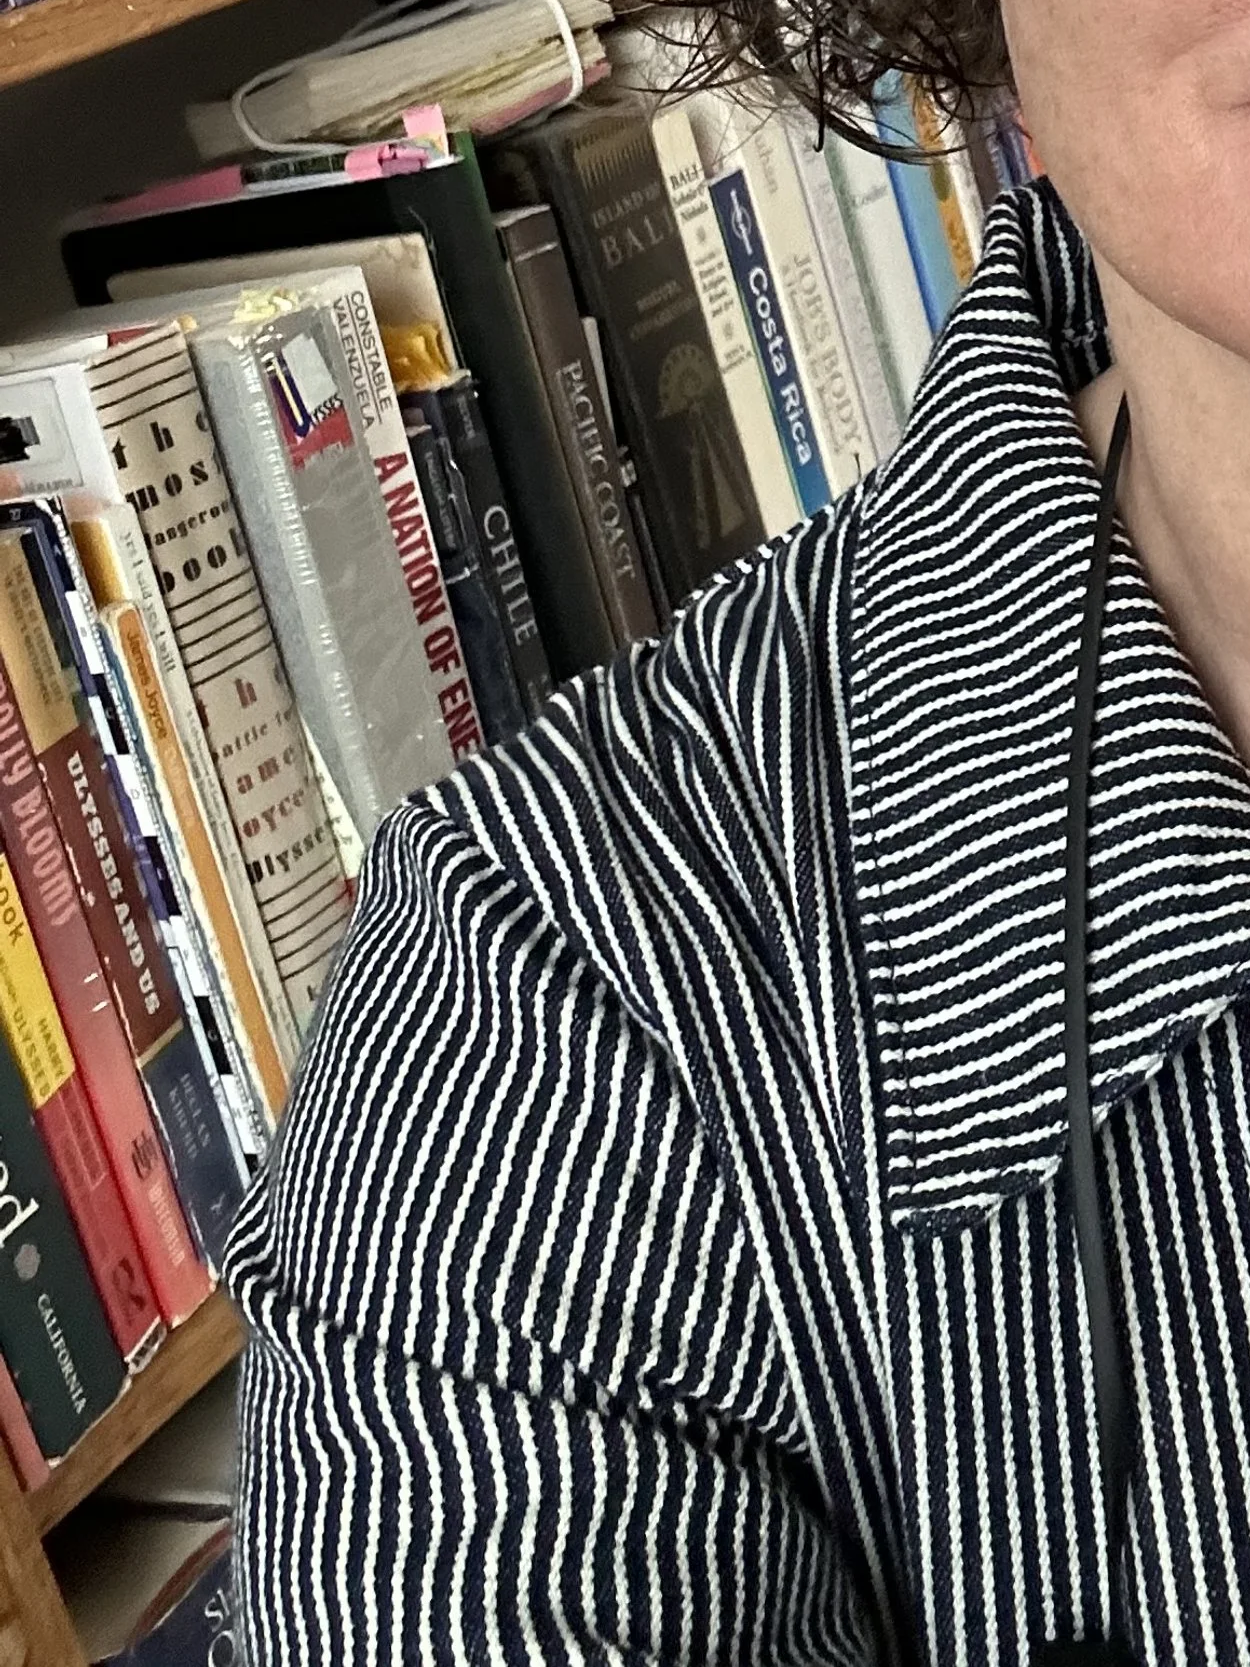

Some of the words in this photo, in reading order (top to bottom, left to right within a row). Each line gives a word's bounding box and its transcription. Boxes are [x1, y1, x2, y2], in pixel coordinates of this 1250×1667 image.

[330, 294, 378, 431] VALENZUELA
[348, 287, 394, 415] CONSTABLE
[744, 263, 794, 378] Costa
[777, 379, 820, 468] Rica
[817, 343, 865, 450] BODY
[125, 449, 221, 511] mos
[372, 448, 411, 480] A
[556, 357, 612, 481] PACIFIC
[590, 477, 640, 584] COAST
[379, 478, 451, 628] NATION
[476, 501, 545, 648] CHILE
[123, 627, 156, 687] James
[141, 684, 173, 742] Joyce
[420, 622, 465, 678] OF
[434, 675, 486, 763] ENE
[62, 750, 127, 901] ULYSSES
[112, 899, 149, 968] AND
[133, 966, 164, 1016] US
[33, 1291, 91, 1416] CALIFORNIA
